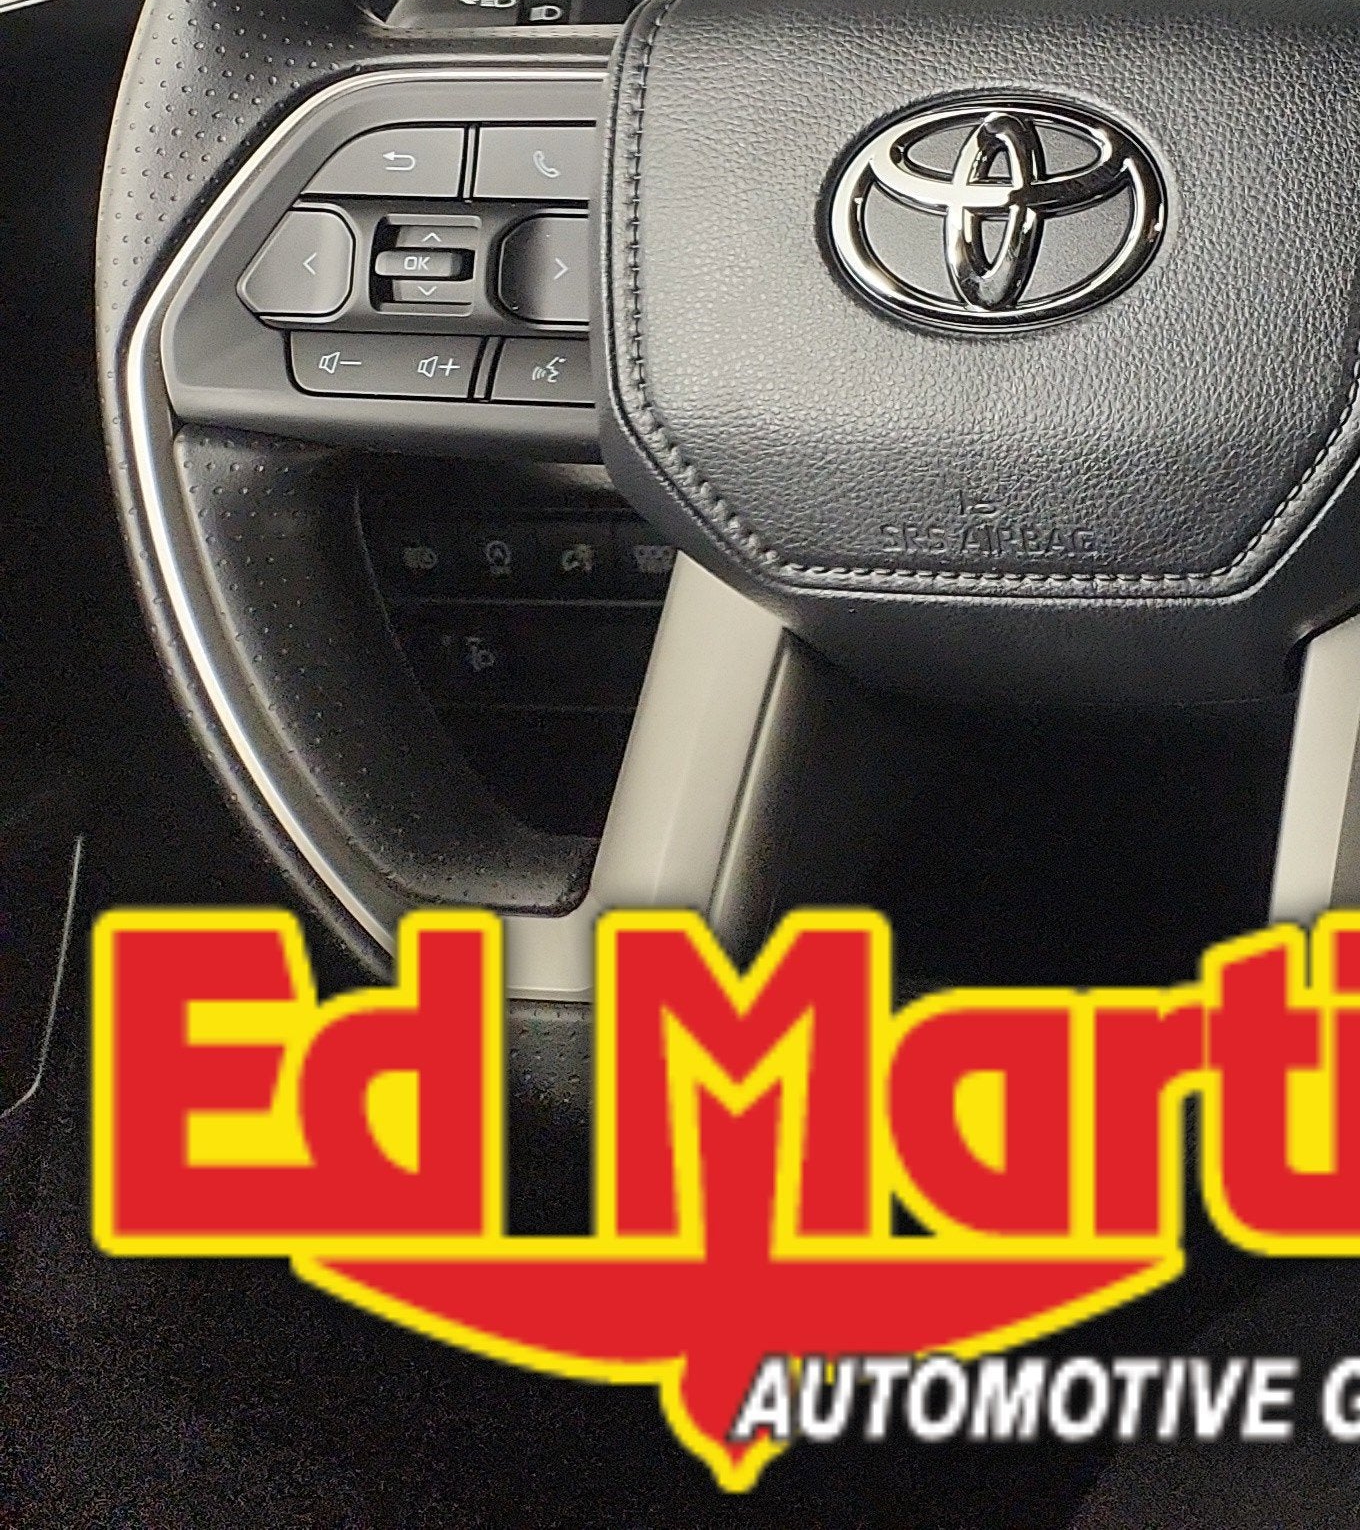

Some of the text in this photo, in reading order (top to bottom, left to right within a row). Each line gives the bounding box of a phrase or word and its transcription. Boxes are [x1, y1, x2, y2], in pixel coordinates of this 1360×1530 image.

[404, 256, 431, 272] OK
[879, 522, 1098, 556] SRS AIRBAG
